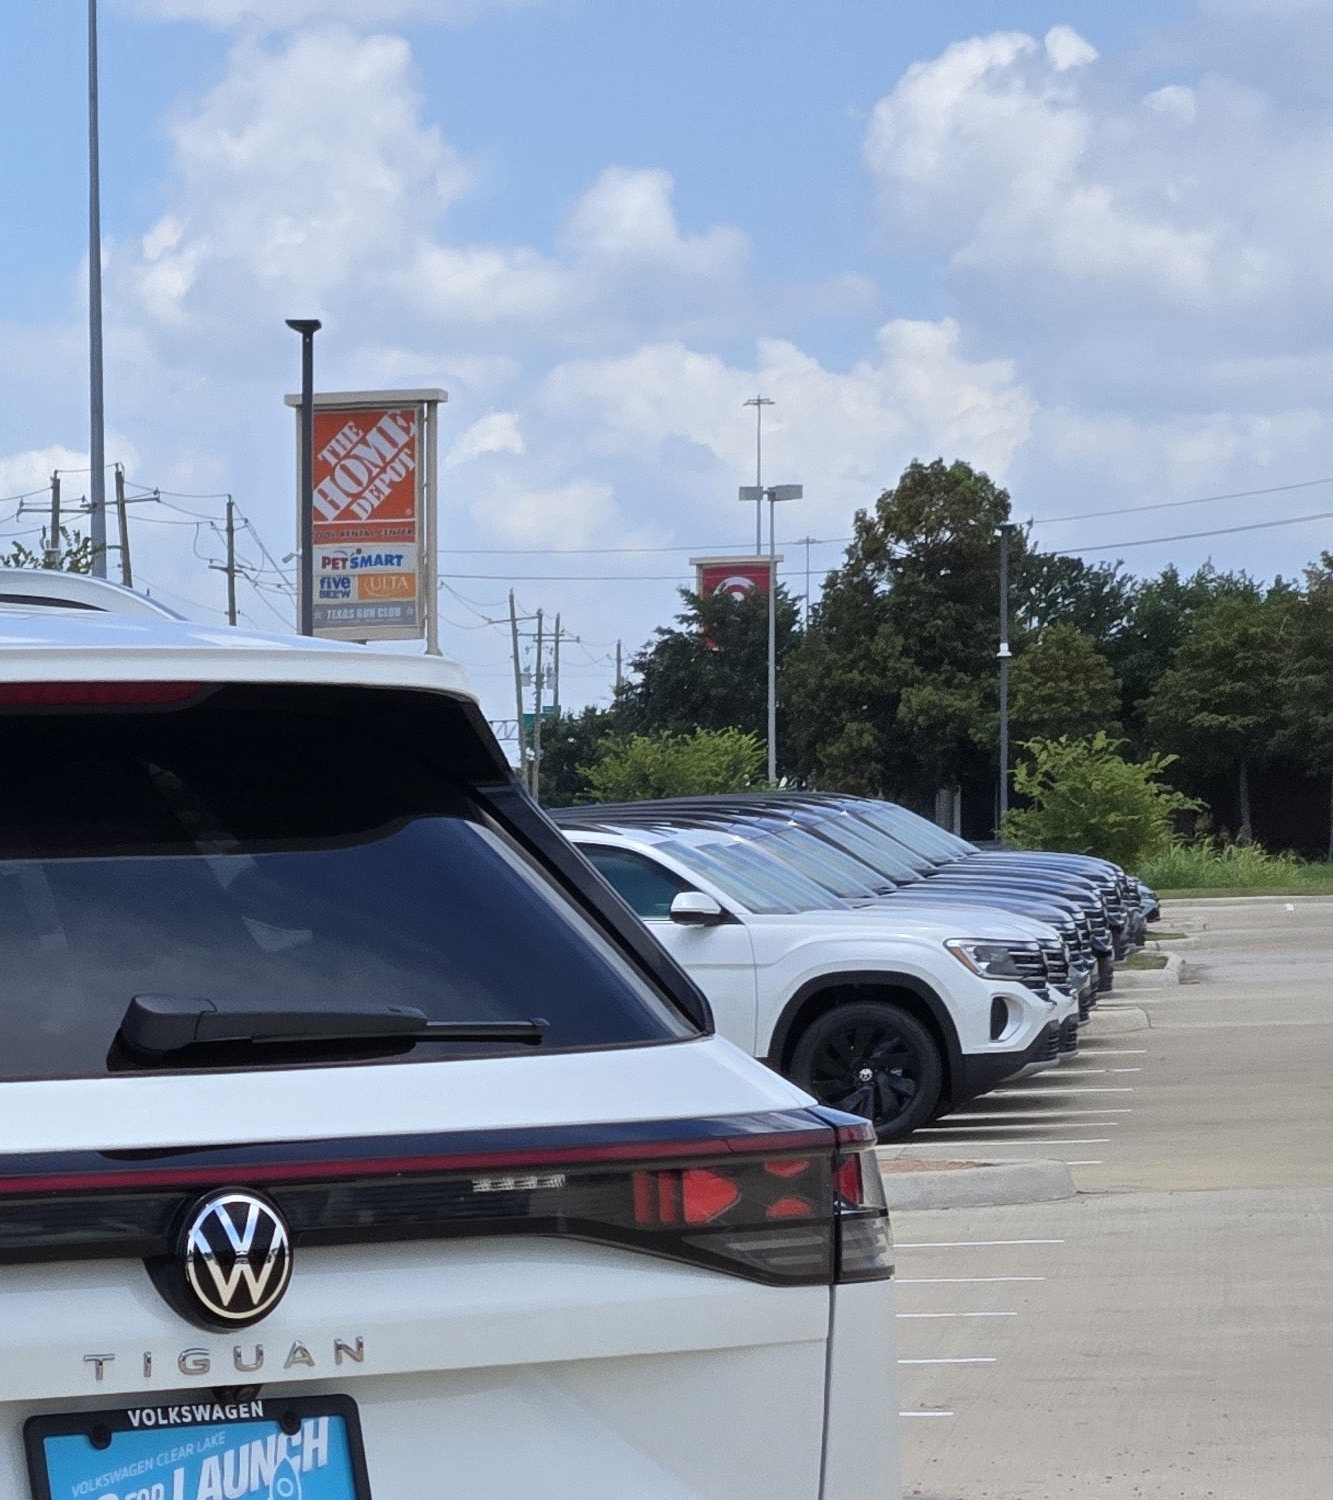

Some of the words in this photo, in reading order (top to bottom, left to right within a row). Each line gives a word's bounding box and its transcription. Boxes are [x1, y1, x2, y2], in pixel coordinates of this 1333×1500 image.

[313, 411, 416, 521] HOME
[317, 420, 364, 467] THE
[349, 449, 415, 521] DEPOT
[369, 576, 409, 590] ULTA
[326, 608, 355, 619] TEXAS
[83, 1336, 365, 1381] TIGUAN
[128, 1400, 264, 1427] VOLKSWAGEN
[71, 1457, 154, 1497] VOLKSWAGEN
[155, 1443, 194, 1468] CLEAR
[196, 1431, 226, 1452] LAKE
